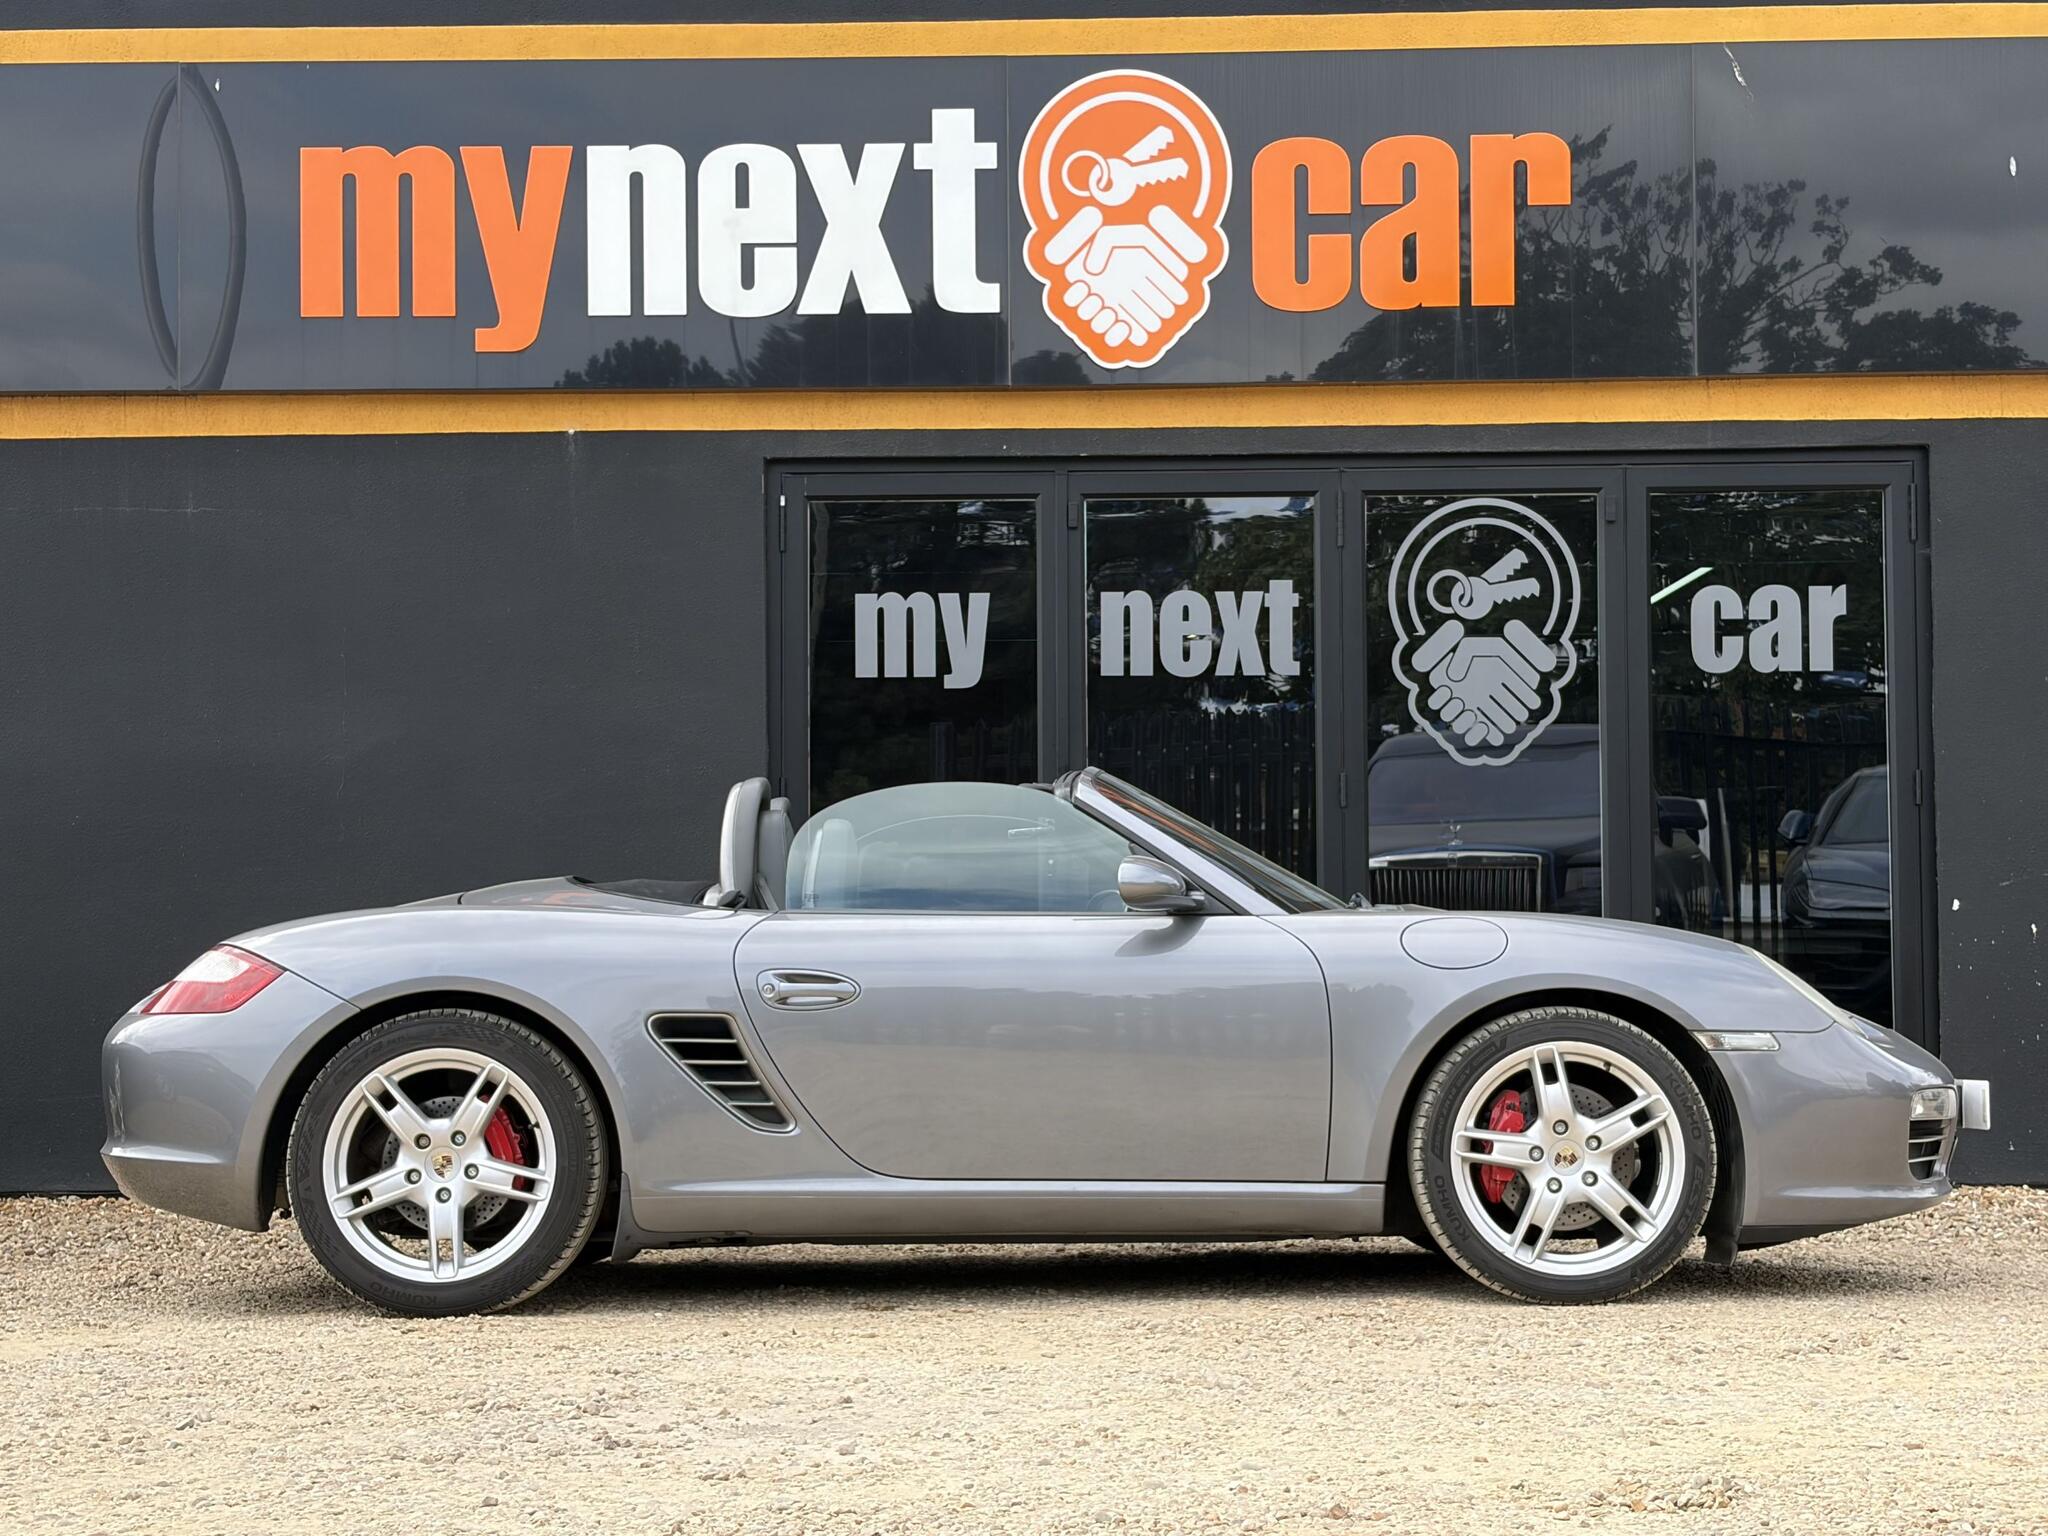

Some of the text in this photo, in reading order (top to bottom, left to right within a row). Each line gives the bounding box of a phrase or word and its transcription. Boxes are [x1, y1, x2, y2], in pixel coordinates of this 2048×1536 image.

[1252, 132, 1572, 312] car
[854, 579, 1847, 689] my next car
[1666, 1072, 1702, 1139] KUMHO
[1434, 1175, 1470, 1241] KUMHO
